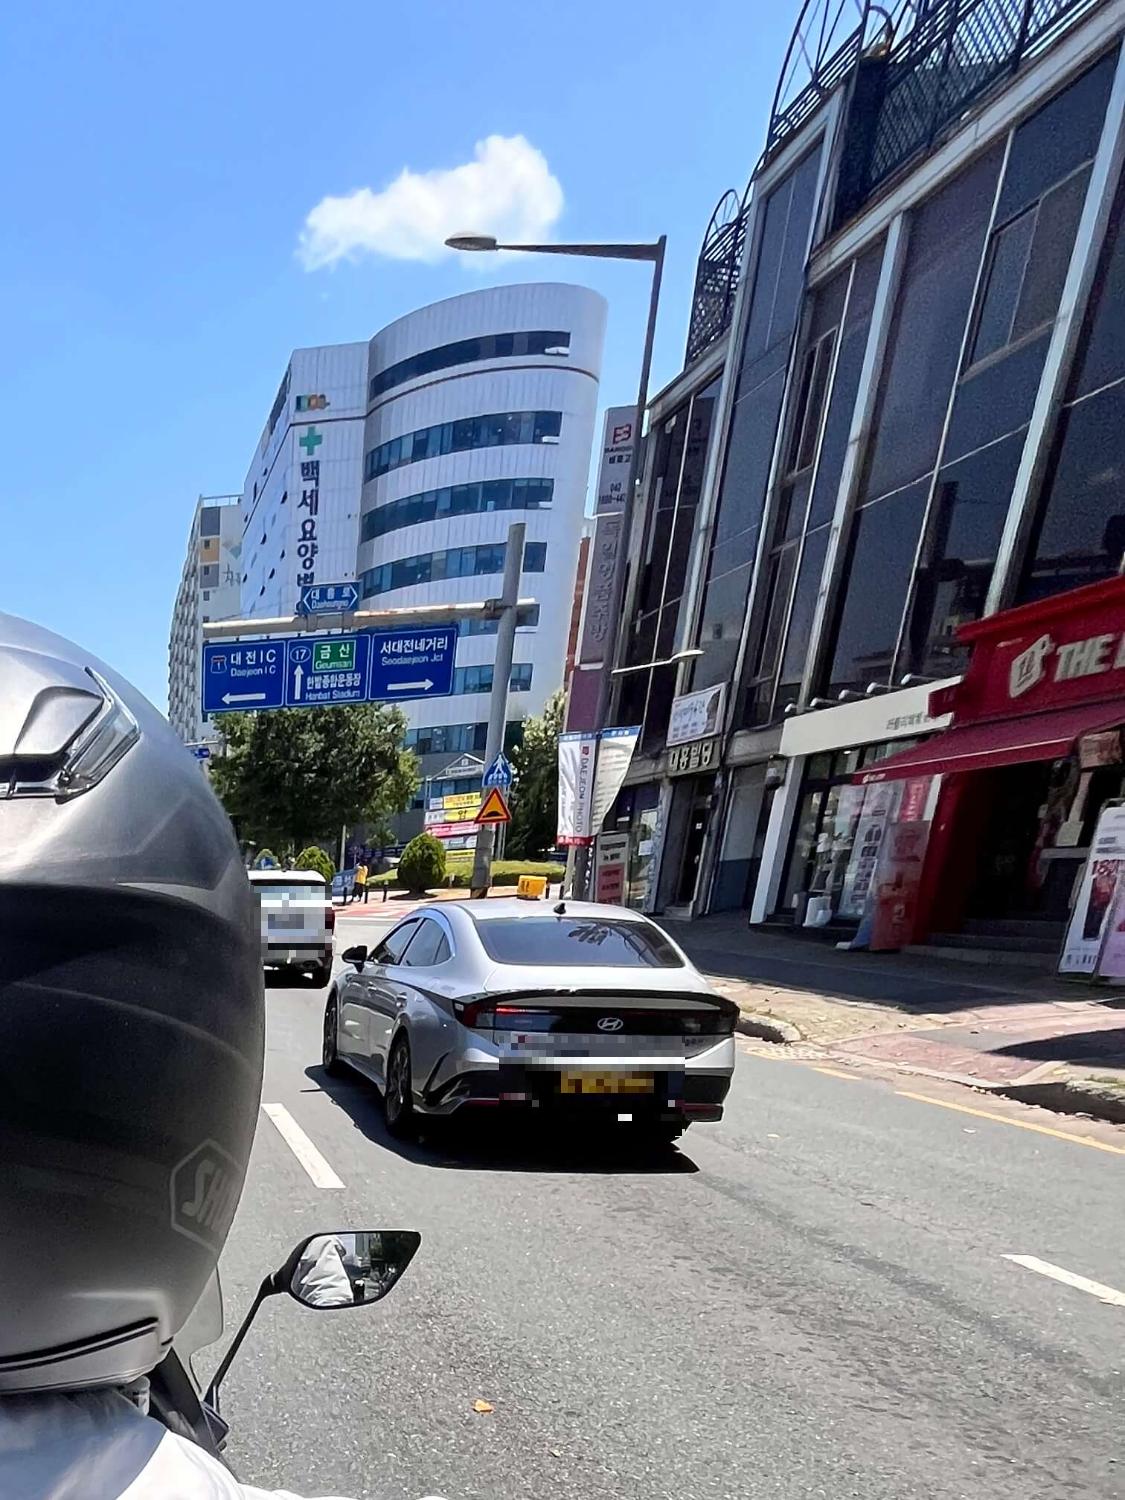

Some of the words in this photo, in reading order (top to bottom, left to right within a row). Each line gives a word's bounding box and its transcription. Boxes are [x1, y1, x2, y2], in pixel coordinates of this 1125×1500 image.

[296, 460, 321, 618] 백세요양병
[296, 649, 307, 660] 17
[320, 643, 350, 660] 금산
[380, 635, 448, 654] 서대전네거리
[1054, 633, 1114, 682] THE
[306, 672, 361, 690] 한밭종합운동장
[670, 740, 713, 771] 대흥빌딩
[579, 757, 590, 799] DAEJEON
[575, 801, 586, 834] PHOTO
